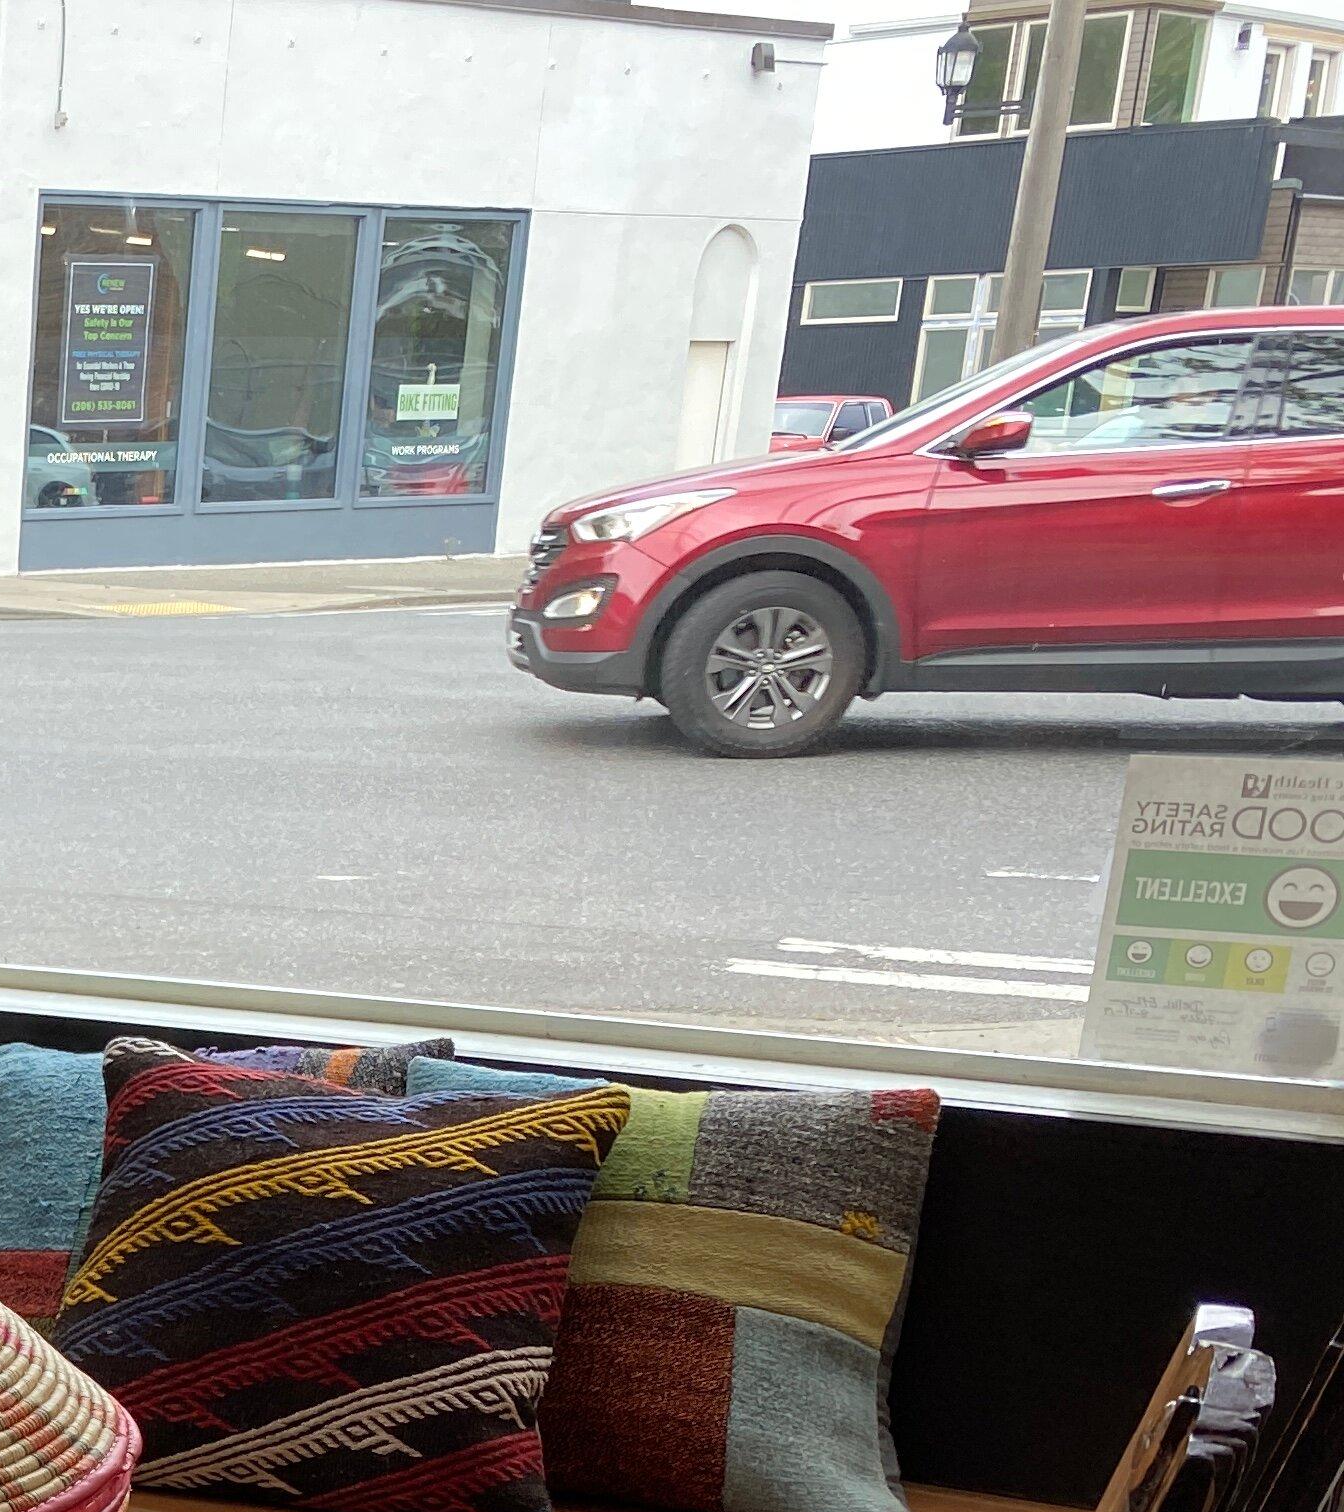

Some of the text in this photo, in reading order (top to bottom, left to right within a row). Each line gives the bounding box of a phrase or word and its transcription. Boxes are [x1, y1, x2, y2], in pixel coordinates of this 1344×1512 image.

[74, 304, 145, 315] YES WE'RE OPEN!
[84, 317, 110, 330] Safety
[118, 318, 134, 328] Our
[83, 331, 133, 342] Top Concern
[399, 393, 458, 412] BIKE FITTING
[391, 444, 460, 456] WORK PROGRAMS
[47, 450, 158, 464] OCCUPATIONAL THERAPY
